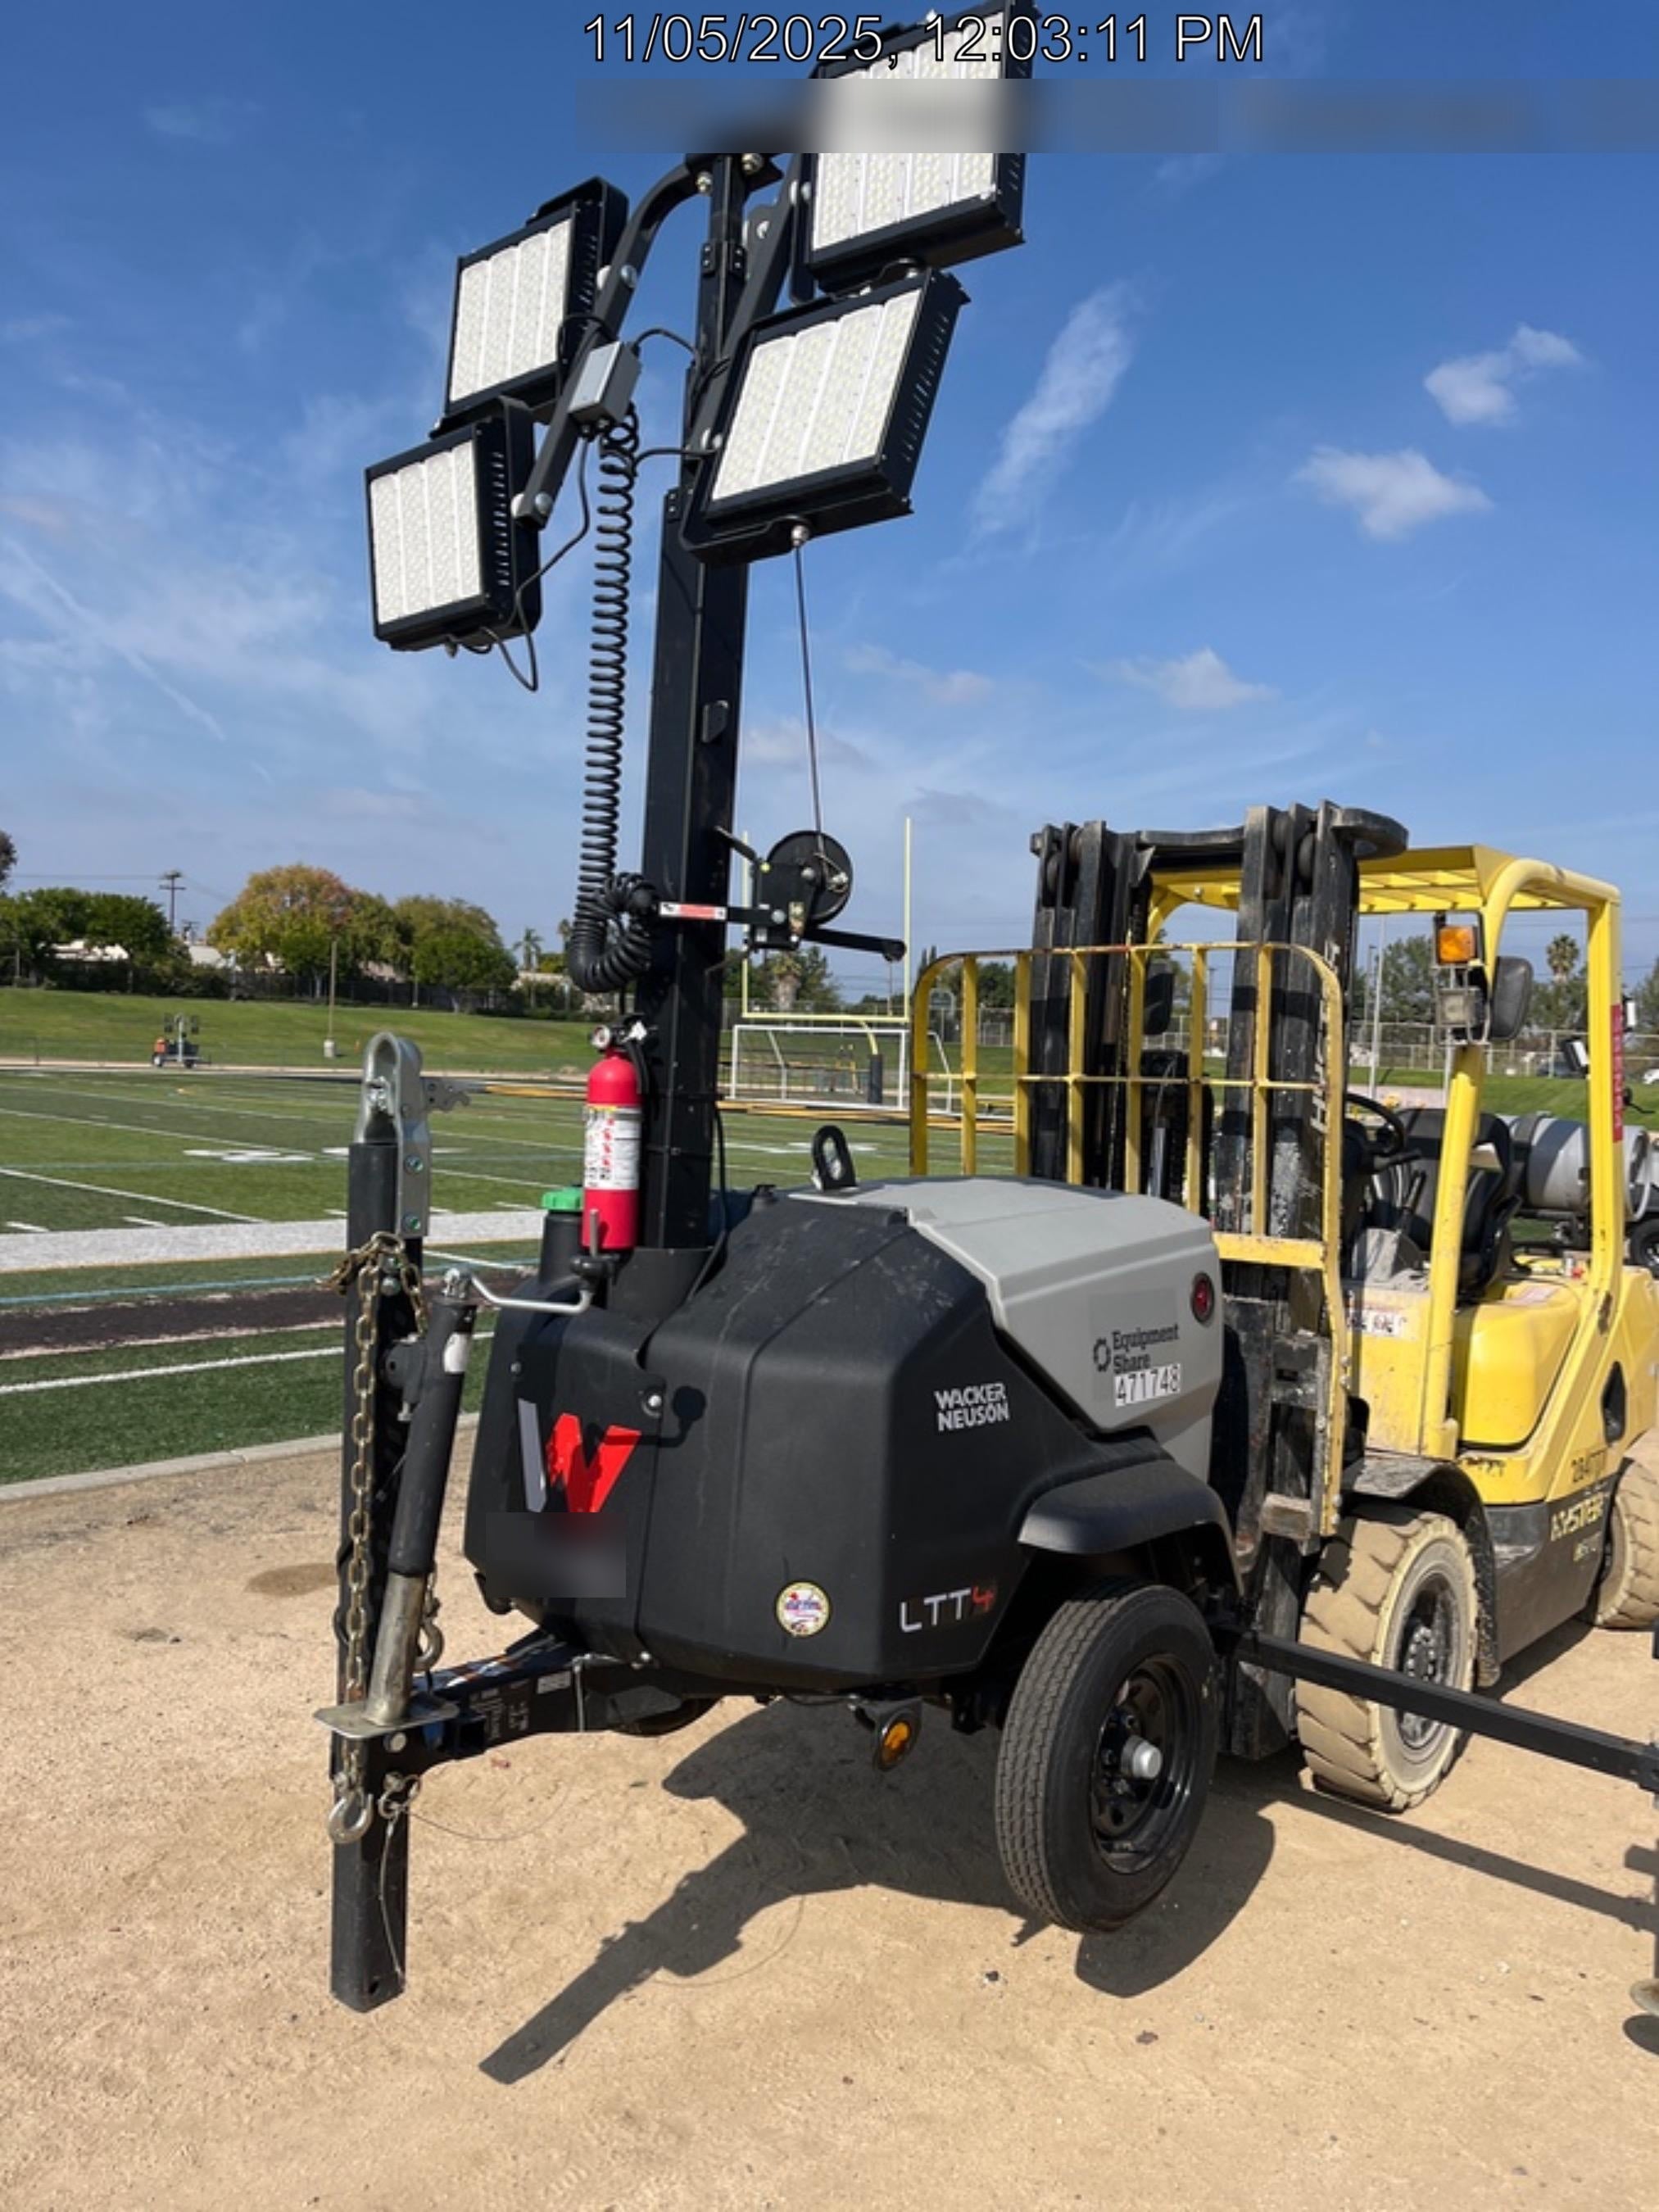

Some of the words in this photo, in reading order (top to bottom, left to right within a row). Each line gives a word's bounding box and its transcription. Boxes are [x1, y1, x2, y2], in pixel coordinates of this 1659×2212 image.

[1113, 1323, 1179, 1352] Equipment
[1113, 1353, 1151, 1375] Share
[934, 1382, 1005, 1410] WACKER
[1117, 1365, 1178, 1403] 471748
[938, 1402, 1009, 1431] NEUSON
[900, 1585, 994, 1633] LTT4
